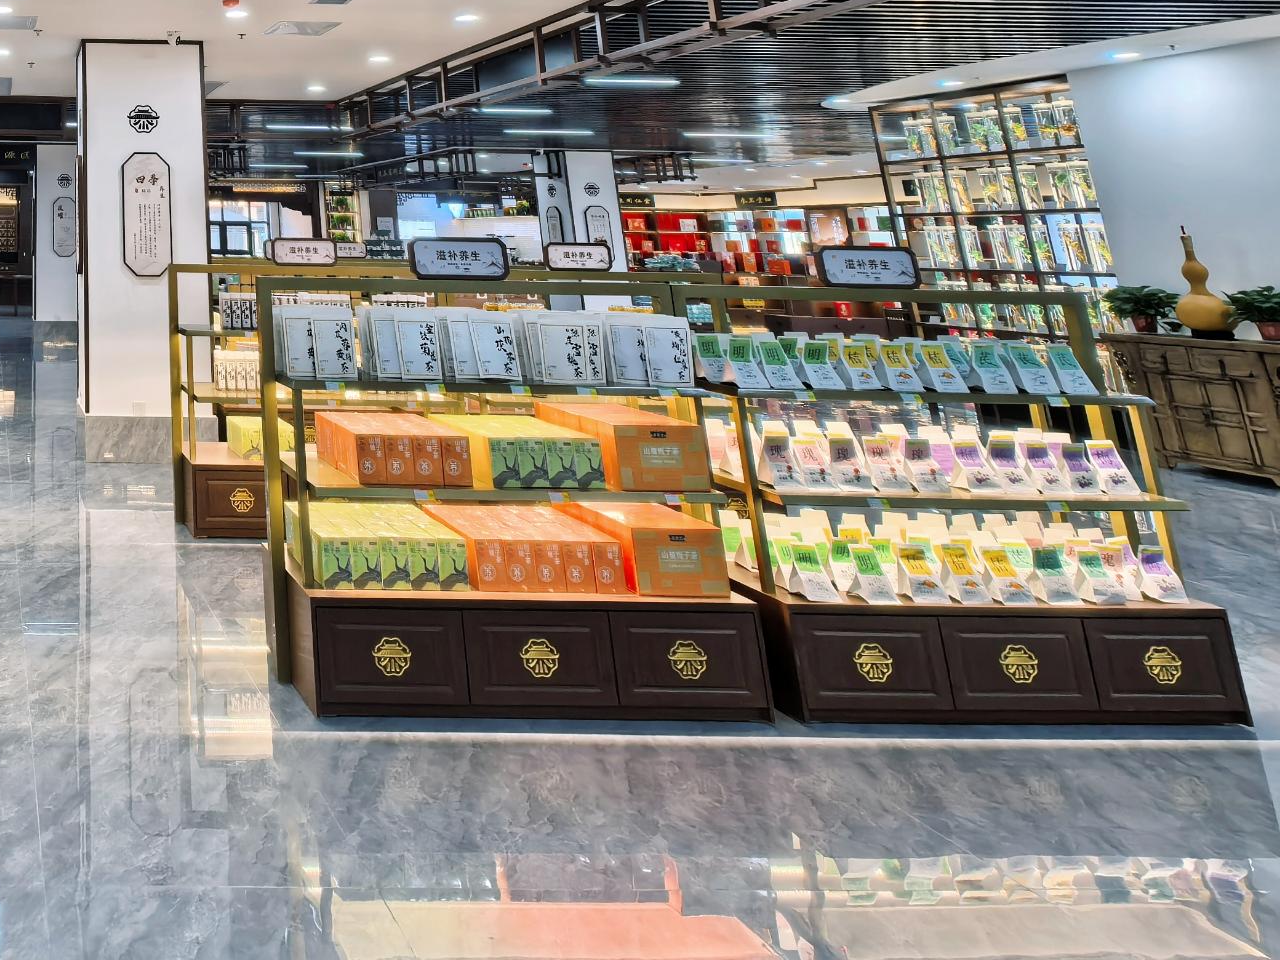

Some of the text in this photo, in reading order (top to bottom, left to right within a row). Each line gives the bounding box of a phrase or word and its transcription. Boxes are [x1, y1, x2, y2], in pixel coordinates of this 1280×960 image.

[436, 249, 481, 262] 滋补养生
[844, 257, 891, 271] 滋补养生
[702, 342, 715, 354] 明
[733, 345, 745, 359] 明
[767, 347, 780, 361] 明
[808, 348, 821, 361] 明
